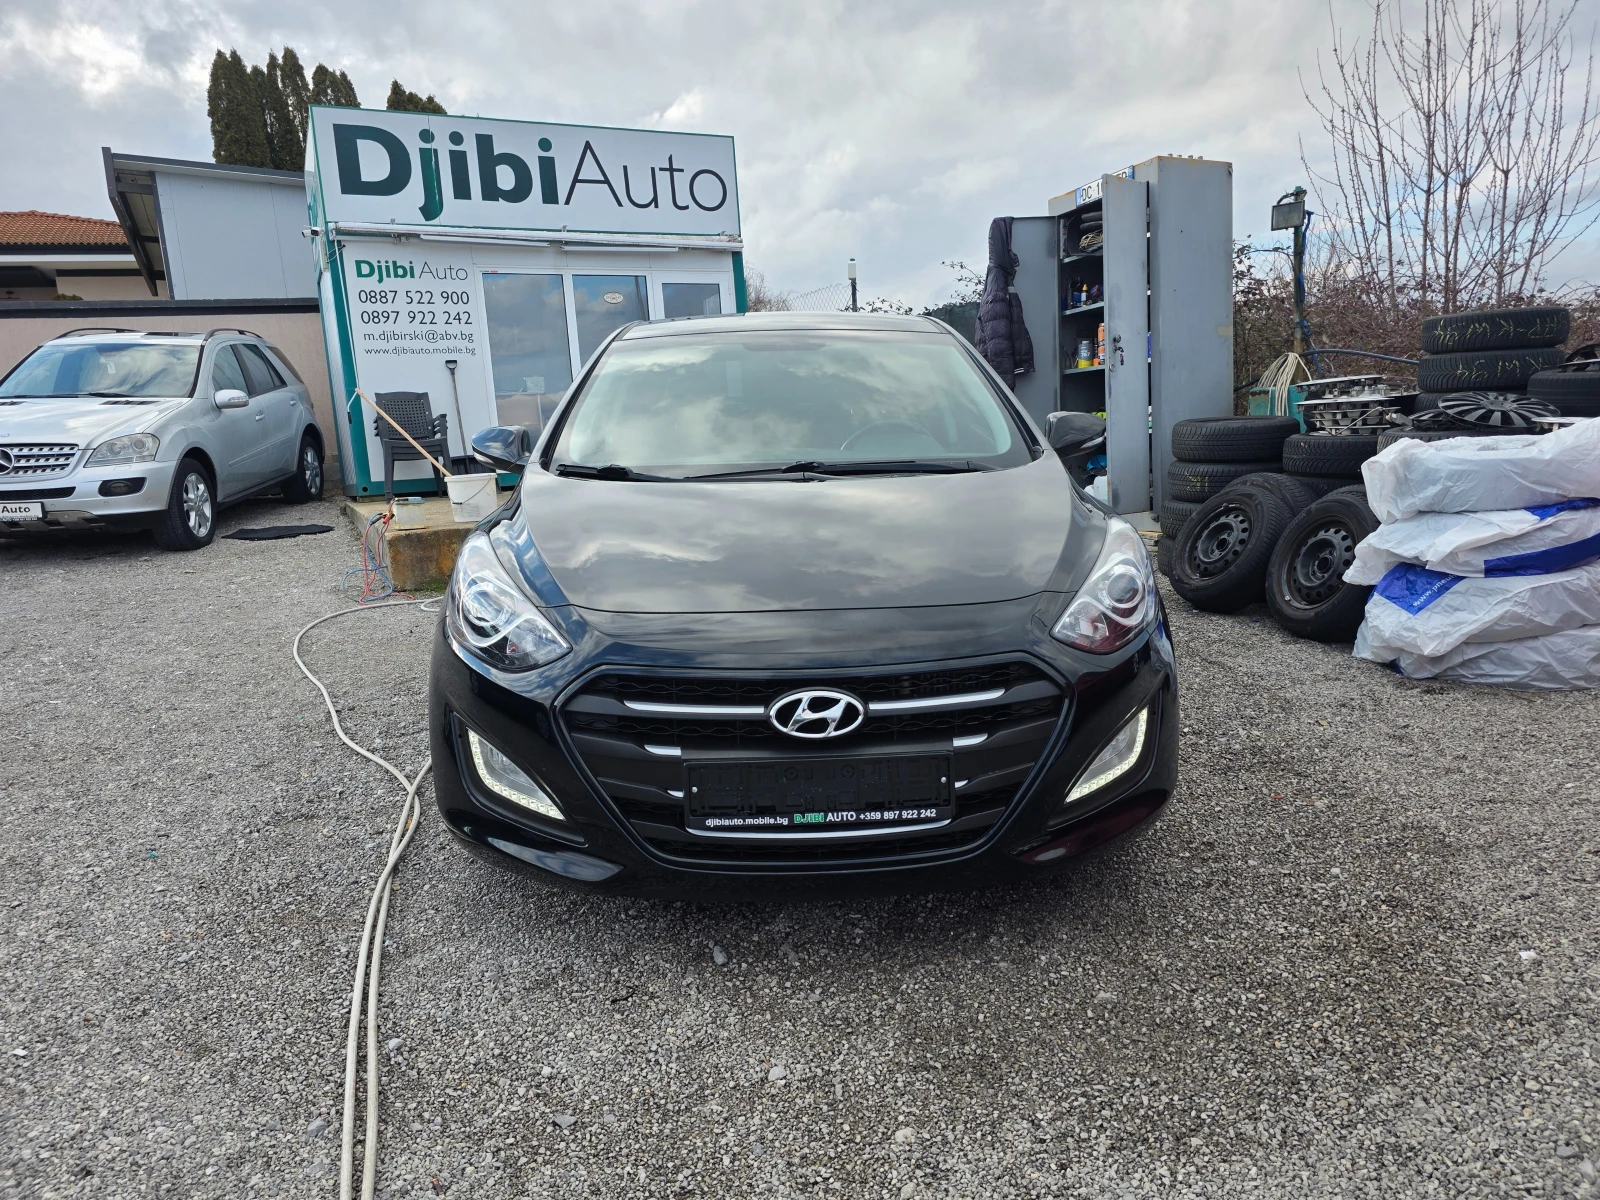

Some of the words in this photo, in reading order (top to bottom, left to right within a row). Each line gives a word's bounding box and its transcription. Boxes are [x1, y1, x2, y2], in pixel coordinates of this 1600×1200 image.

[355, 260, 415, 284] Djibi
[419, 261, 468, 280] Auto
[358, 290, 398, 304] 0887
[405, 290, 435, 304] 522
[440, 291, 470, 305] 900
[361, 310, 400, 325] 0897
[407, 310, 437, 325] 922
[442, 311, 473, 325] 242
[363, 329, 475, 343] m.djibirski@abv.bg
[364, 346, 477, 356] www.djibiauto.mobile.bg
[705, 815, 789, 827] djibiauto.mobile.bg
[794, 813, 825, 823] DJIBI
[826, 811, 857, 822] AUTO
[859, 811, 881, 820] +359
[883, 810, 900, 820] 897
[901, 809, 918, 819] 922
[919, 808, 937, 818] 242
